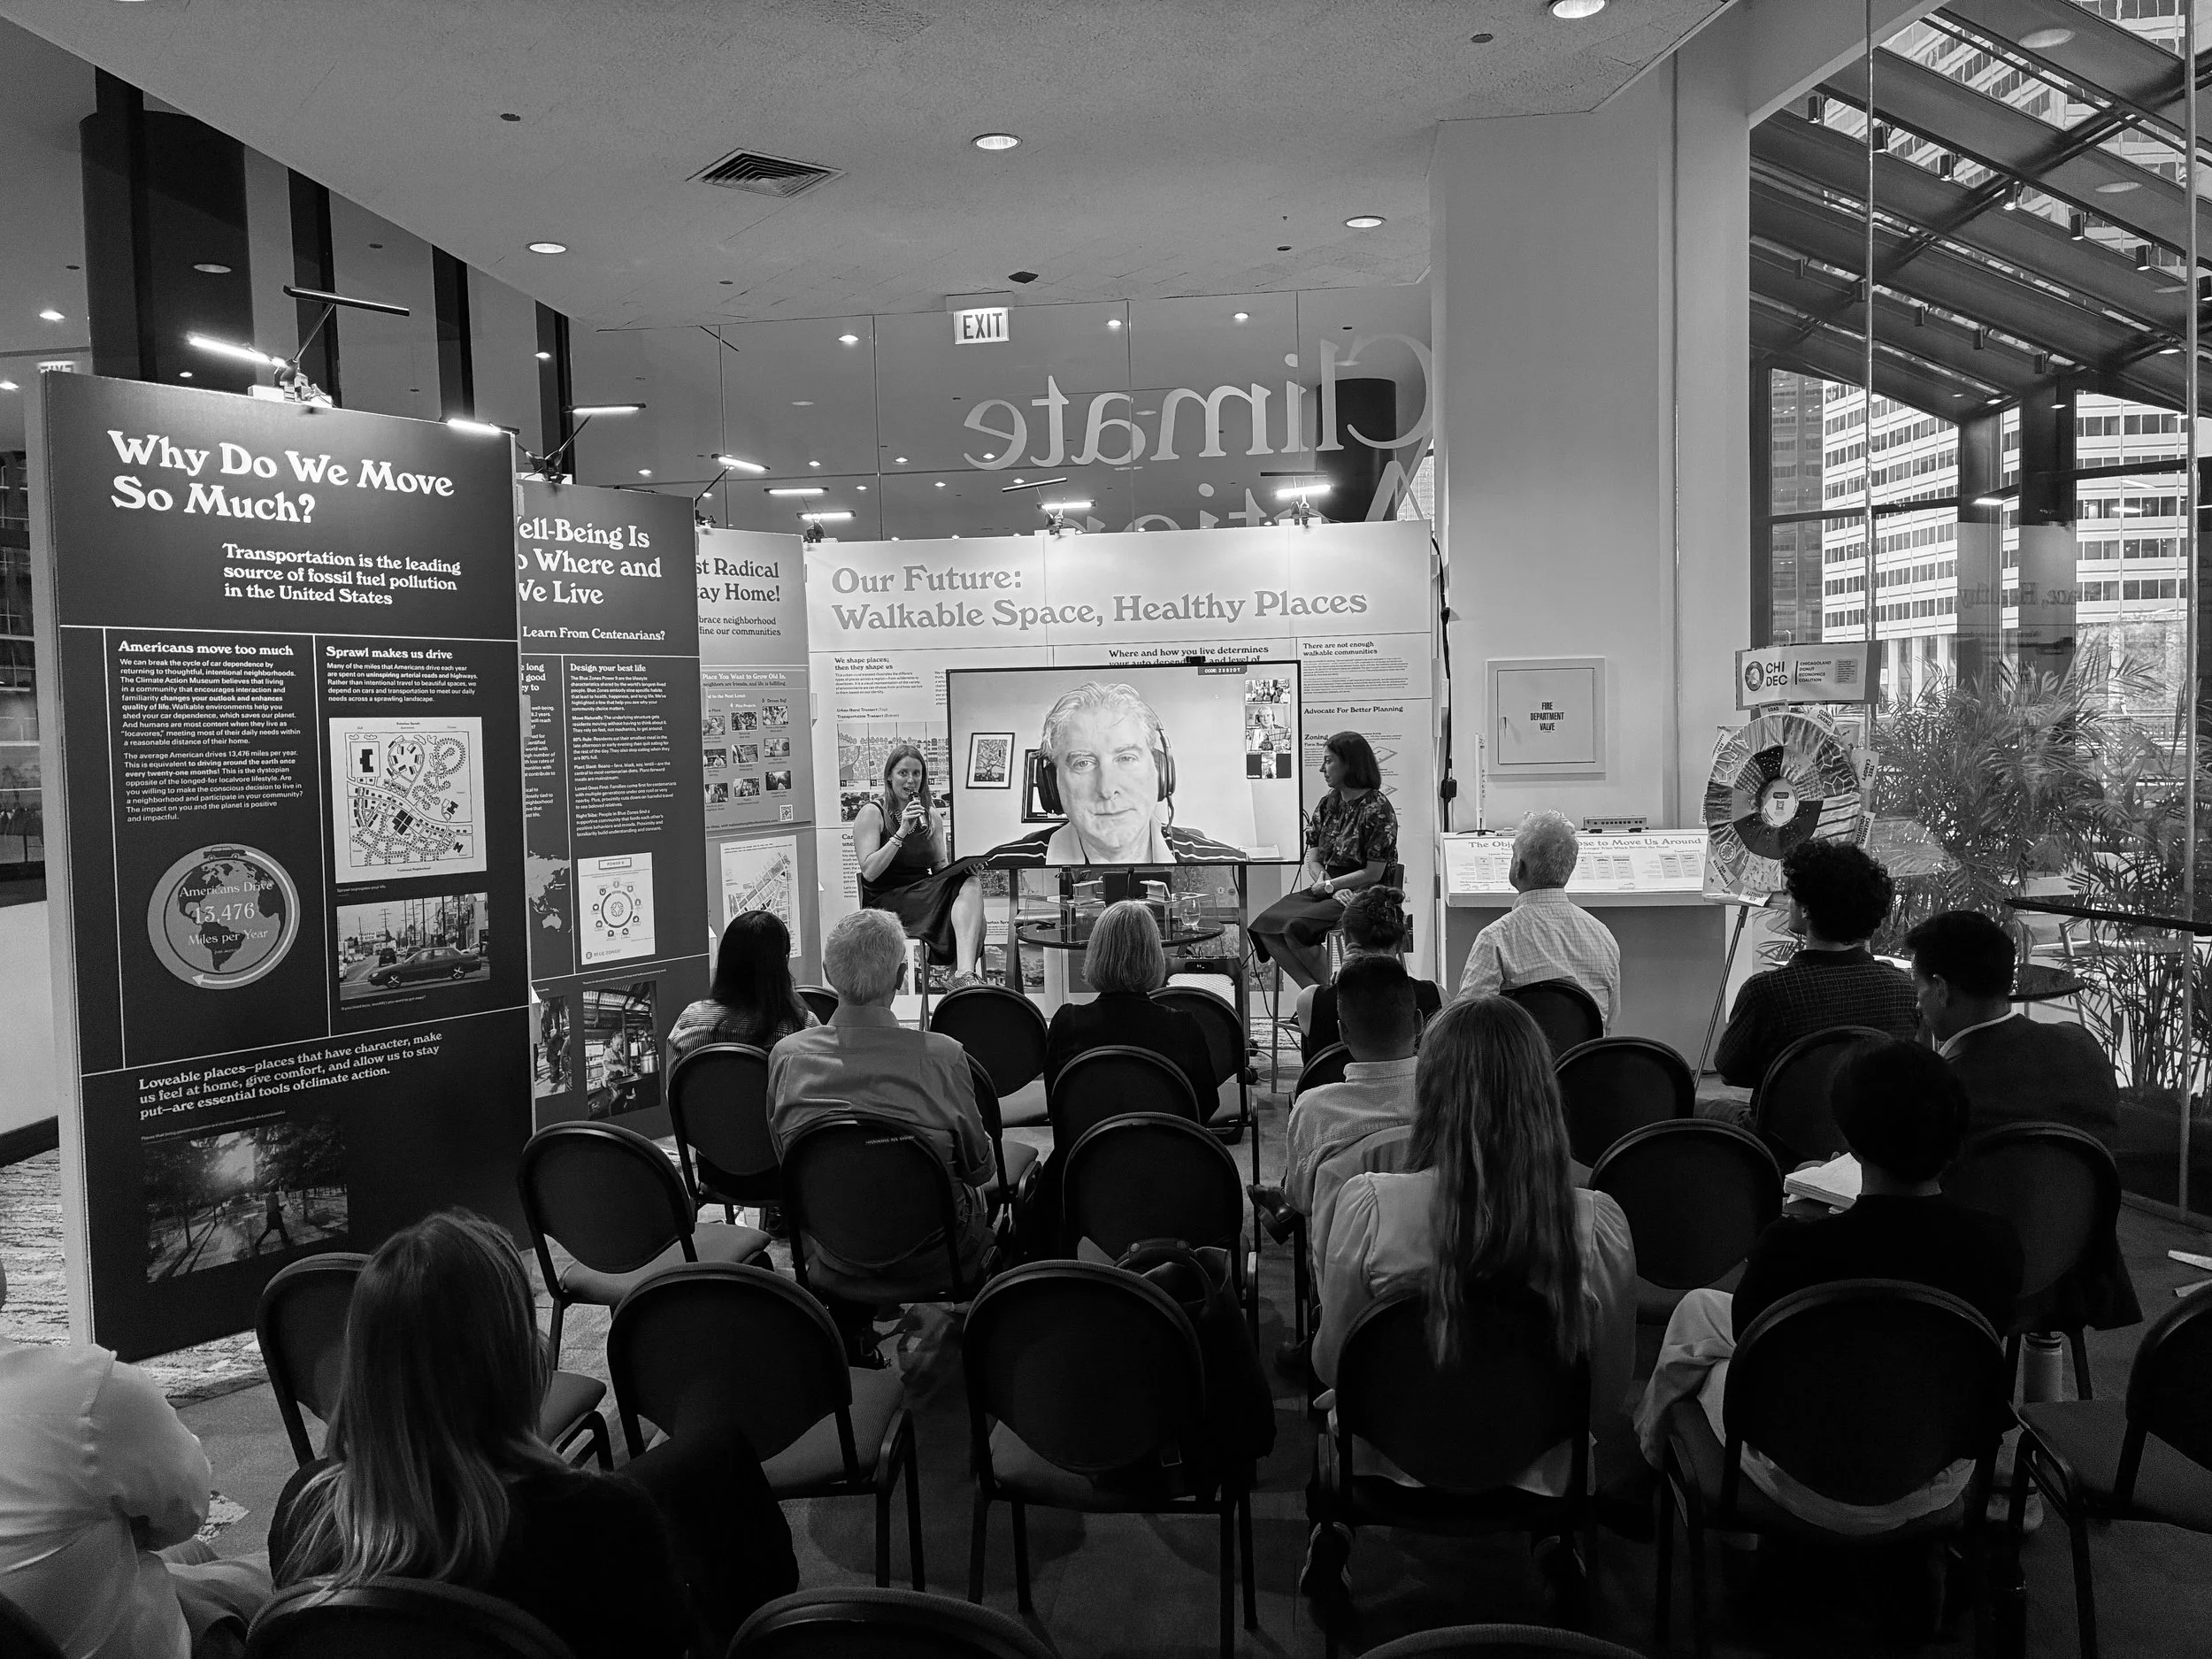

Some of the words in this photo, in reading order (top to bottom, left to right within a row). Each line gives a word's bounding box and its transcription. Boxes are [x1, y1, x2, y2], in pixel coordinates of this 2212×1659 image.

[963, 312, 1002, 339] EXIT
[107, 430, 210, 477] Why
[219, 442, 278, 478] Do
[285, 450, 349, 485] We
[356, 459, 455, 497] Move
[111, 477, 173, 510] So
[185, 483, 316, 522] Much?
[518, 516, 623, 550] ell-Being
[628, 525, 650, 548] Is
[222, 544, 355, 565] Transportation
[359, 552, 373, 567] is
[377, 553, 402, 568] the
[406, 555, 462, 576] leading
[533, 548, 614, 574] Where
[620, 557, 662, 577] and
[696, 559, 710, 574] st
[714, 558, 779, 578] Radical
[223, 570, 283, 581] source
[287, 569, 304, 582] of
[308, 569, 353, 585] fossil
[356, 572, 385, 586] fuel
[390, 575, 457, 591] pollution
[832, 567, 895, 595] Our
[903, 566, 1023, 593] Future:
[224, 583, 242, 597] in
[246, 584, 275, 598] the
[279, 585, 335, 601] United
[339, 588, 392, 604] States
[552, 580, 604, 604] Live
[697, 587, 720, 603] ay
[725, 583, 780, 602] Home!
[723, 616, 776, 626] neighborhood
[832, 603, 985, 631] Walkable
[992, 599, 1104, 631] Space,
[1113, 591, 1245, 625] Healthy
[1254, 590, 1368, 618] Places
[523, 626, 557, 638] Learn
[559, 627, 589, 638] From
[591, 628, 665, 641] Centenarians?
[699, 626, 714, 634] fine
[118, 641, 194, 653] Americans
[235, 644, 256, 654] too
[259, 645, 294, 655] much
[326, 647, 369, 658] Sprawl
[372, 648, 408, 658] makes
[426, 649, 453, 659] drive
[1218, 646, 1269, 654] determines
[570, 663, 597, 672] Design
[599, 664, 615, 673] your
[1766, 661, 1784, 674] CHI
[1766, 675, 1788, 686] DEC
[1530, 712, 1564, 720] DEPARTMENT
[179, 884, 240, 897] Americans
[243, 881, 274, 891] Drive
[195, 902, 255, 924] 13,476
[188, 933, 218, 945] Miles
[222, 934, 241, 945] per
[243, 929, 268, 939] Year
[139, 1072, 201, 1089] Loveable
[204, 1059, 295, 1082] places—places
[298, 1051, 322, 1063] that
[325, 1049, 352, 1059] have
[355, 1039, 411, 1054] character,
[413, 1032, 442, 1044] make
[159, 1087, 183, 1100] feel
[186, 1084, 200, 1095] at
[203, 1082, 242, 1092] home,
[246, 1074, 271, 1088] give
[274, 1064, 325, 1080] comfort,
[329, 1059, 350, 1071] and
[353, 1055, 384, 1066] allow
[402, 1049, 414, 1058] to
[416, 1045, 439, 1056] stay
[140, 1102, 194, 1118] put—are
[197, 1088, 256, 1106] essential
[259, 1083, 290, 1095] tools
[352, 1067, 390, 1080] action.
